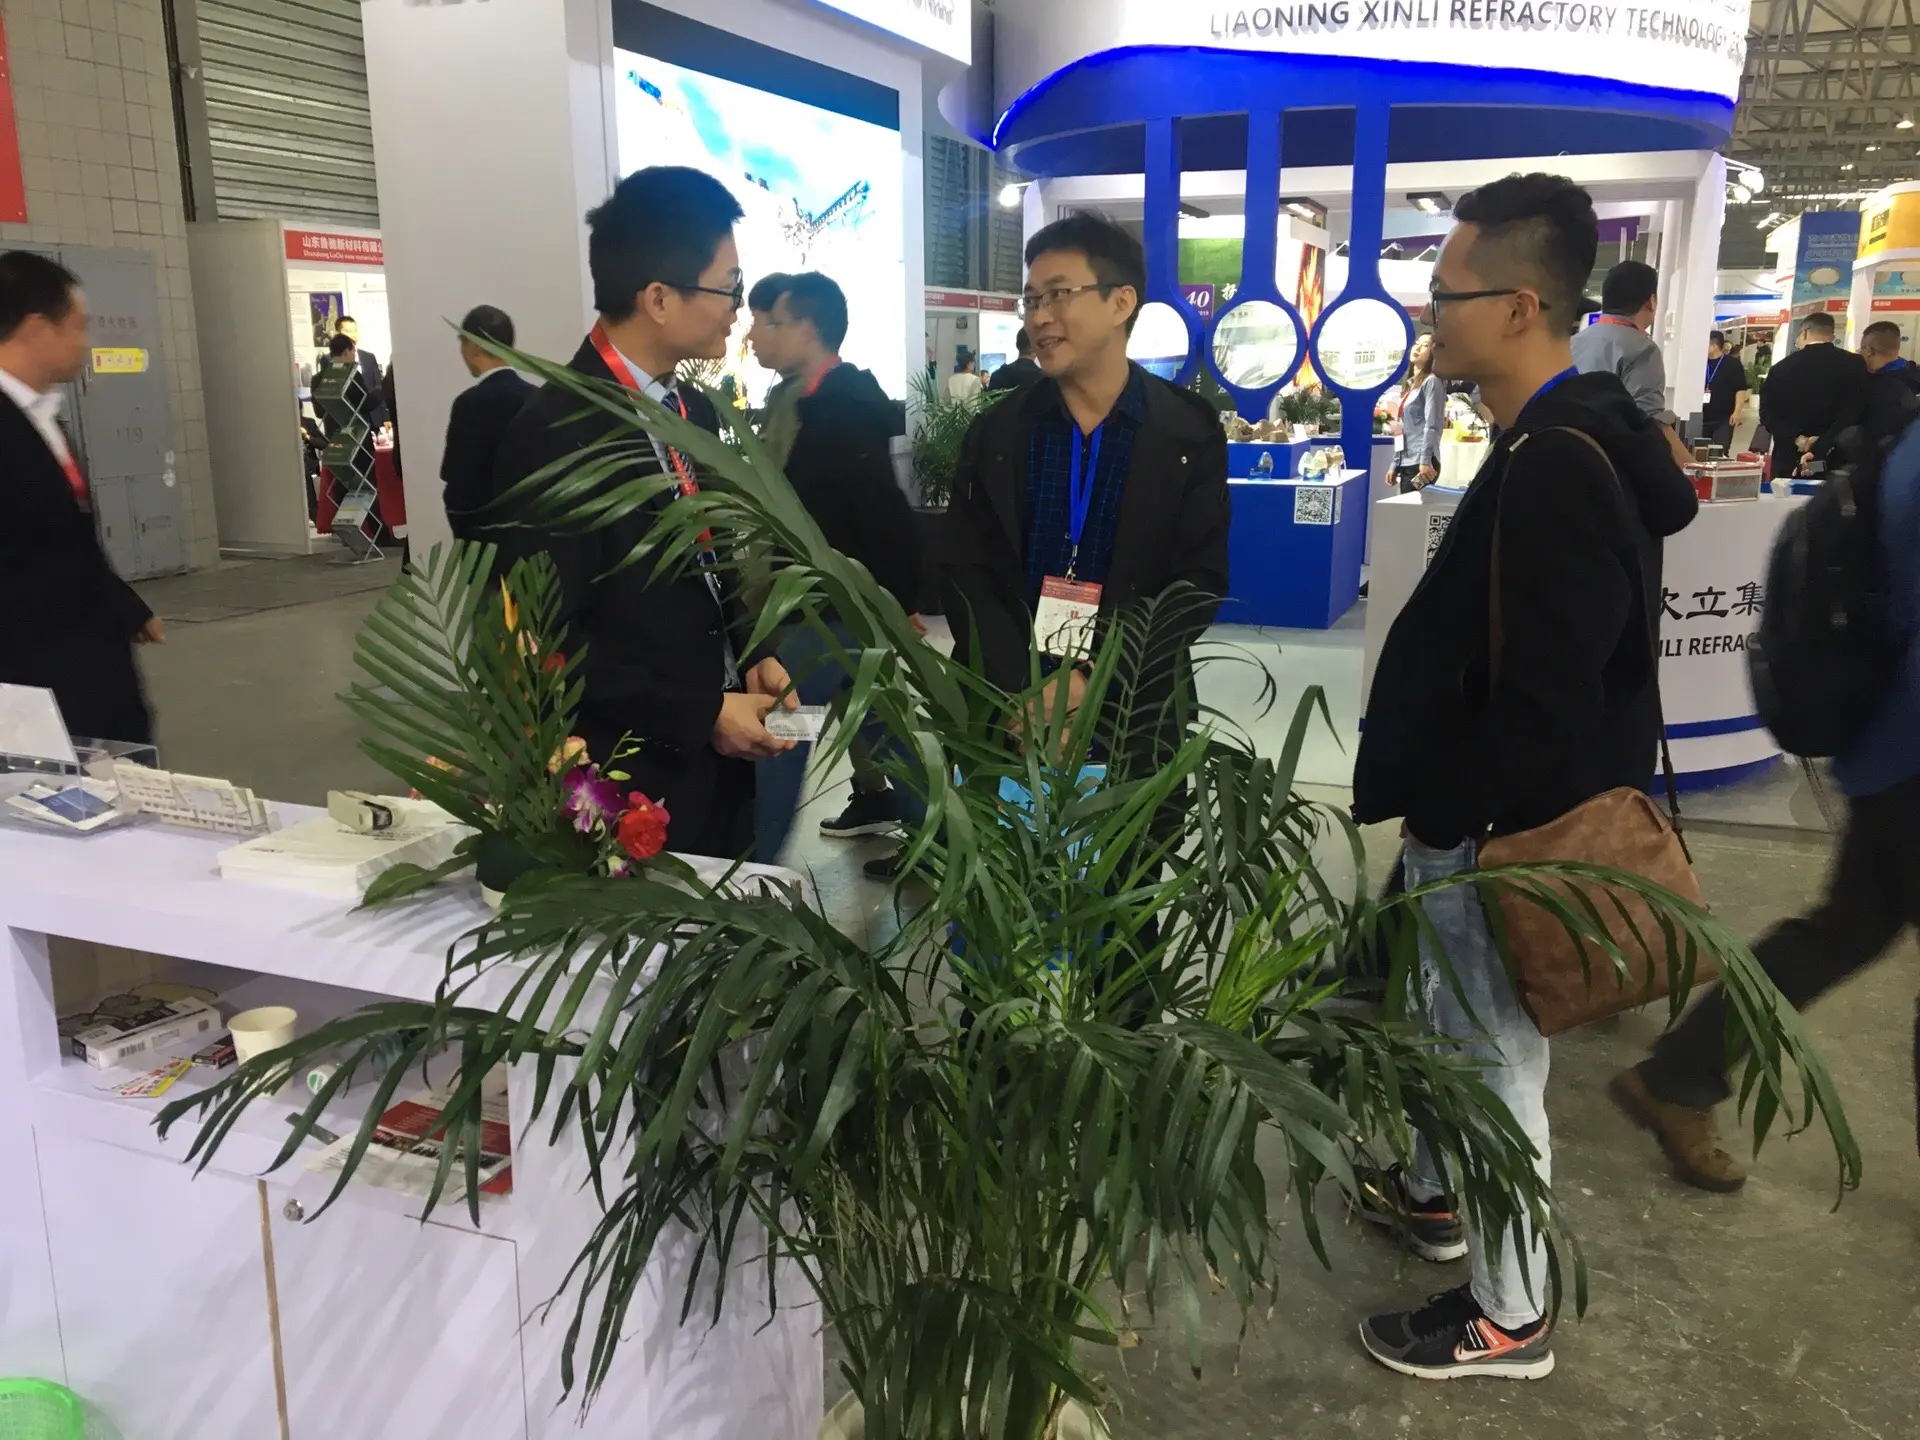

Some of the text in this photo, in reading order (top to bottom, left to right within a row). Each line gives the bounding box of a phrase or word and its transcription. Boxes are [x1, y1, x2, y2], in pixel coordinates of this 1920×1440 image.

[1211, 1, 1349, 36] LIAONING
[1361, 0, 1438, 24] XINLI
[1450, 0, 1617, 28] REFRACTORY
[1627, 7, 1727, 47] TECHNOLOG
